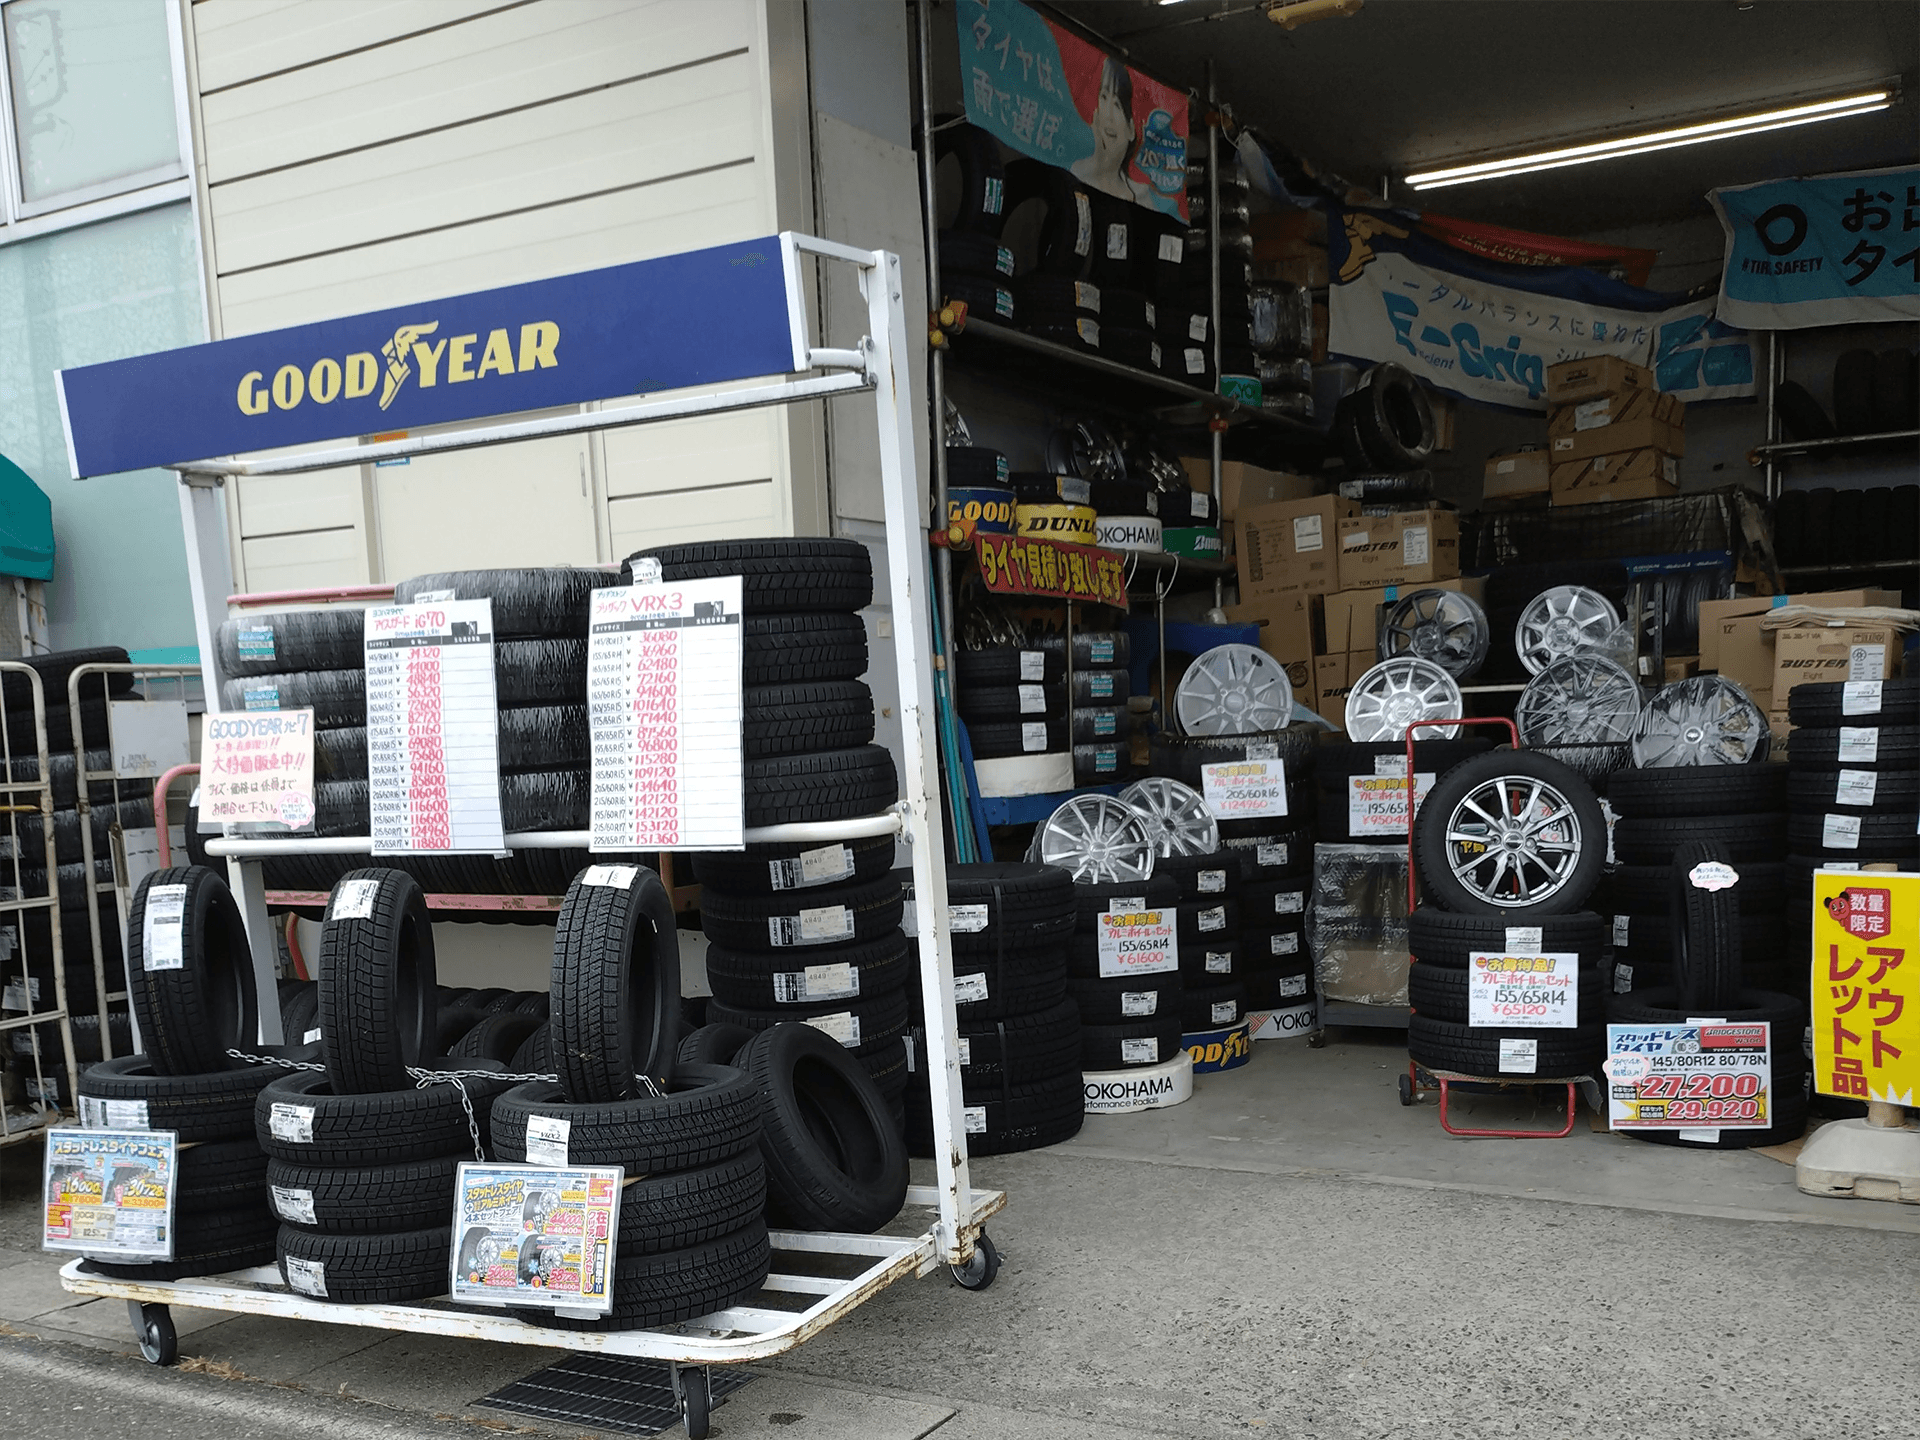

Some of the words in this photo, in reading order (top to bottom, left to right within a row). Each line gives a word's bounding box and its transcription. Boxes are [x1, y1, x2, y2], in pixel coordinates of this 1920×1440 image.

[973, 14, 1063, 101] タイヤは、
[1390, 275, 1647, 346] ータルバランスに優れた
[237, 321, 560, 416] GOODYEAR
[1027, 516, 1096, 532] DUNL
[1097, 526, 1159, 544] OKOHAMA
[981, 540, 1124, 602] タイヤ見積り致します
[374, 616, 411, 632] アイスガード
[415, 611, 446, 629] iG70
[639, 630, 678, 643] 36080
[407, 647, 441, 660] 34320
[638, 643, 677, 658] 36960
[406, 660, 440, 674] 44000
[638, 657, 677, 671] 62480
[1781, 659, 1848, 670] BUSTER
[406, 673, 440, 686] 48840
[638, 671, 676, 685] 72160
[1803, 671, 1823, 681] Eight
[407, 686, 441, 699] 56320
[637, 684, 677, 698] 94600
[407, 698, 441, 711] 72600
[633, 697, 676, 711] 101640
[408, 711, 441, 724] 82720
[408, 724, 441, 736] 61160
[637, 725, 677, 739] 87560
[408, 736, 442, 749] 69080
[638, 738, 678, 752] 96800
[409, 749, 443, 762] 75680
[635, 752, 678, 765] 115280
[410, 761, 444, 774] 94160
[635, 766, 676, 779] 109120
[411, 774, 446, 787] 85800
[635, 779, 677, 792] 134640
[409, 786, 447, 800] 106040
[635, 792, 678, 806] 142120
[410, 799, 448, 812] 116600
[410, 812, 449, 825] 116600
[635, 806, 678, 820] 142120
[411, 823, 449, 837] 124960
[636, 819, 678, 833] 153120
[412, 837, 450, 849] 118800
[636, 831, 679, 845] 151360
[1850, 893, 1885, 913] 数量
[1850, 914, 1885, 934] 限定
[1119, 937, 1169, 953] 155/65R14
[1117, 951, 1164, 965] ¥61600
[1494, 990, 1567, 1006] 155/65R14
[1491, 1003, 1547, 1016] ¥65120
[1866, 946, 1905, 1069] アウト
[1828, 944, 1869, 1097] レット品
[1616, 1028, 1698, 1043] スタッドレス
[1704, 1028, 1762, 1036] BRIDGESTONE
[1615, 1042, 1663, 1053] タイヤ
[1652, 1056, 1716, 1067] 145/80R12
[1719, 1055, 1767, 1066] 80/78N
[1639, 1075, 1760, 1099] 27,200
[1133, 1095, 1159, 1107] Radials
[1667, 1100, 1759, 1119] 29,920
[584, 1211, 596, 1291] クリアランスセール
